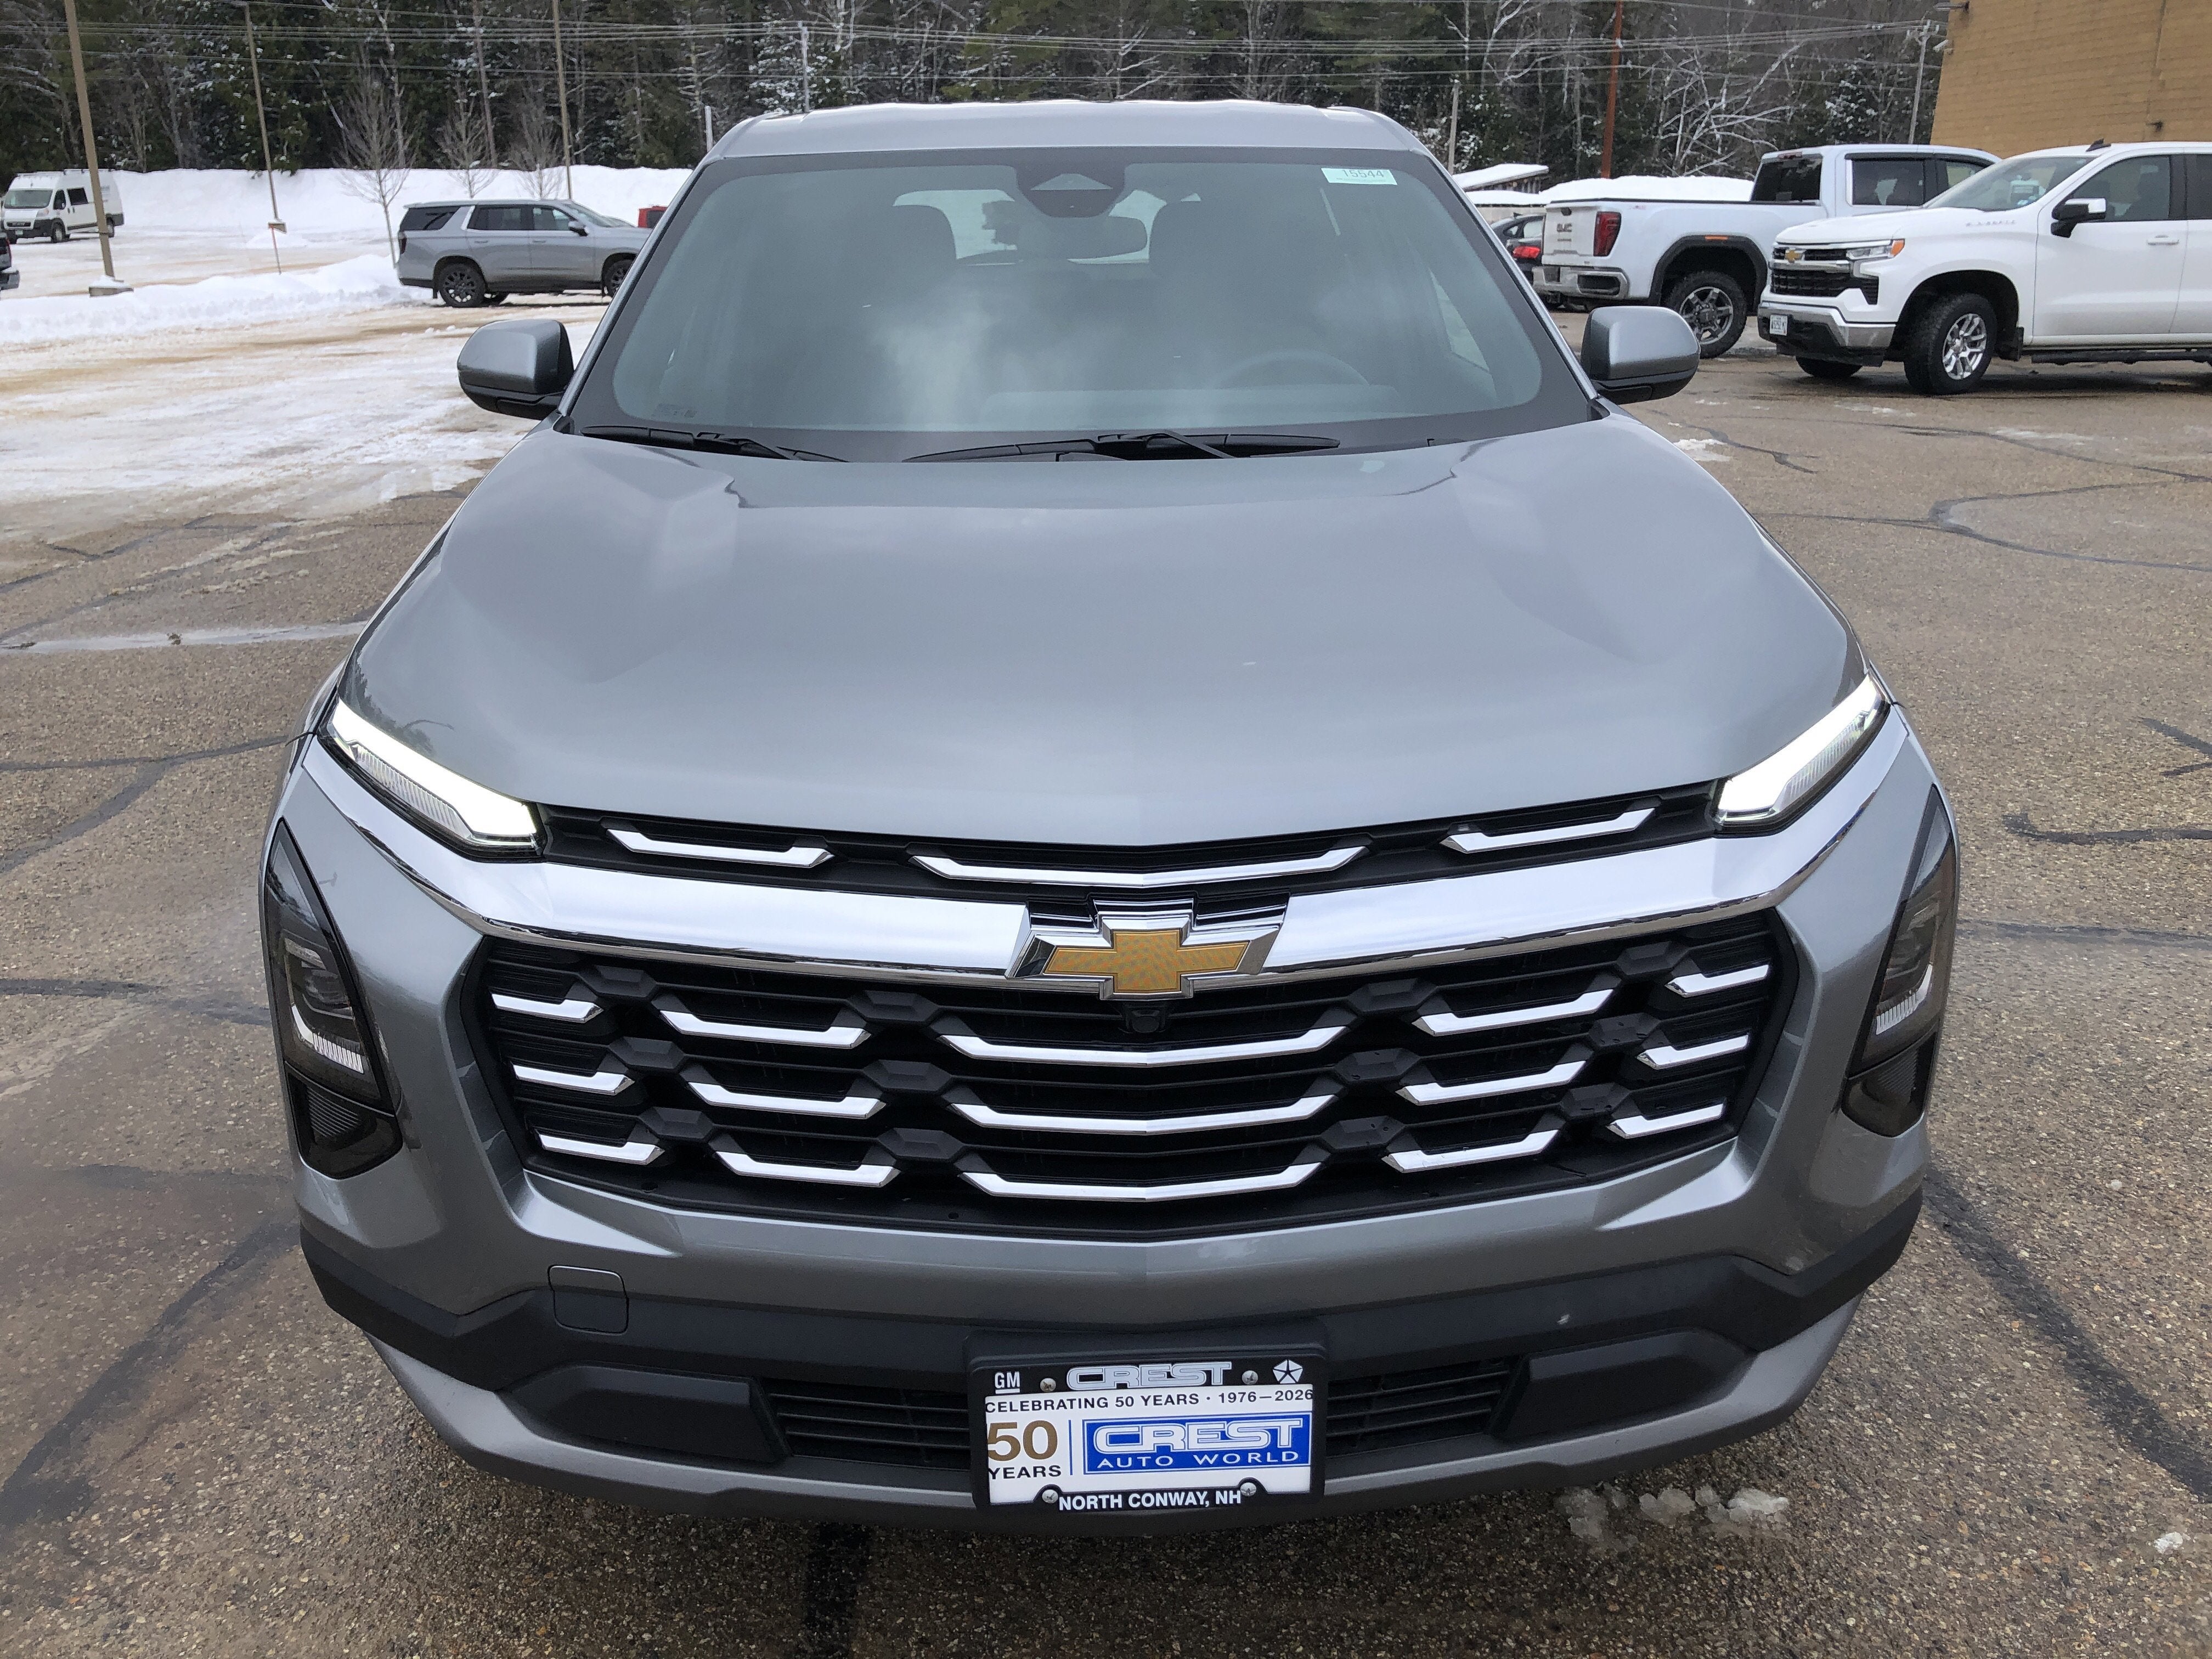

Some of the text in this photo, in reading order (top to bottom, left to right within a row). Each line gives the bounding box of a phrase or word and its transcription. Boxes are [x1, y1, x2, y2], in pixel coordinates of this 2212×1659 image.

[1342, 169, 1384, 178] 15544
[995, 1372, 1020, 1389] GM
[1066, 1361, 1232, 1391] CREST
[985, 1398, 1108, 1413] CELEBRATING
[1115, 1396, 1134, 1407] 50
[1141, 1393, 1199, 1406] YEARS
[988, 1420, 1058, 1462] 50
[1093, 1418, 1303, 1454] CREST
[1097, 1451, 1299, 1469] AUTO WORLD
[988, 1465, 1062, 1480] YEARS
[1059, 1489, 1242, 1511] NORTH CONWAY, NH
